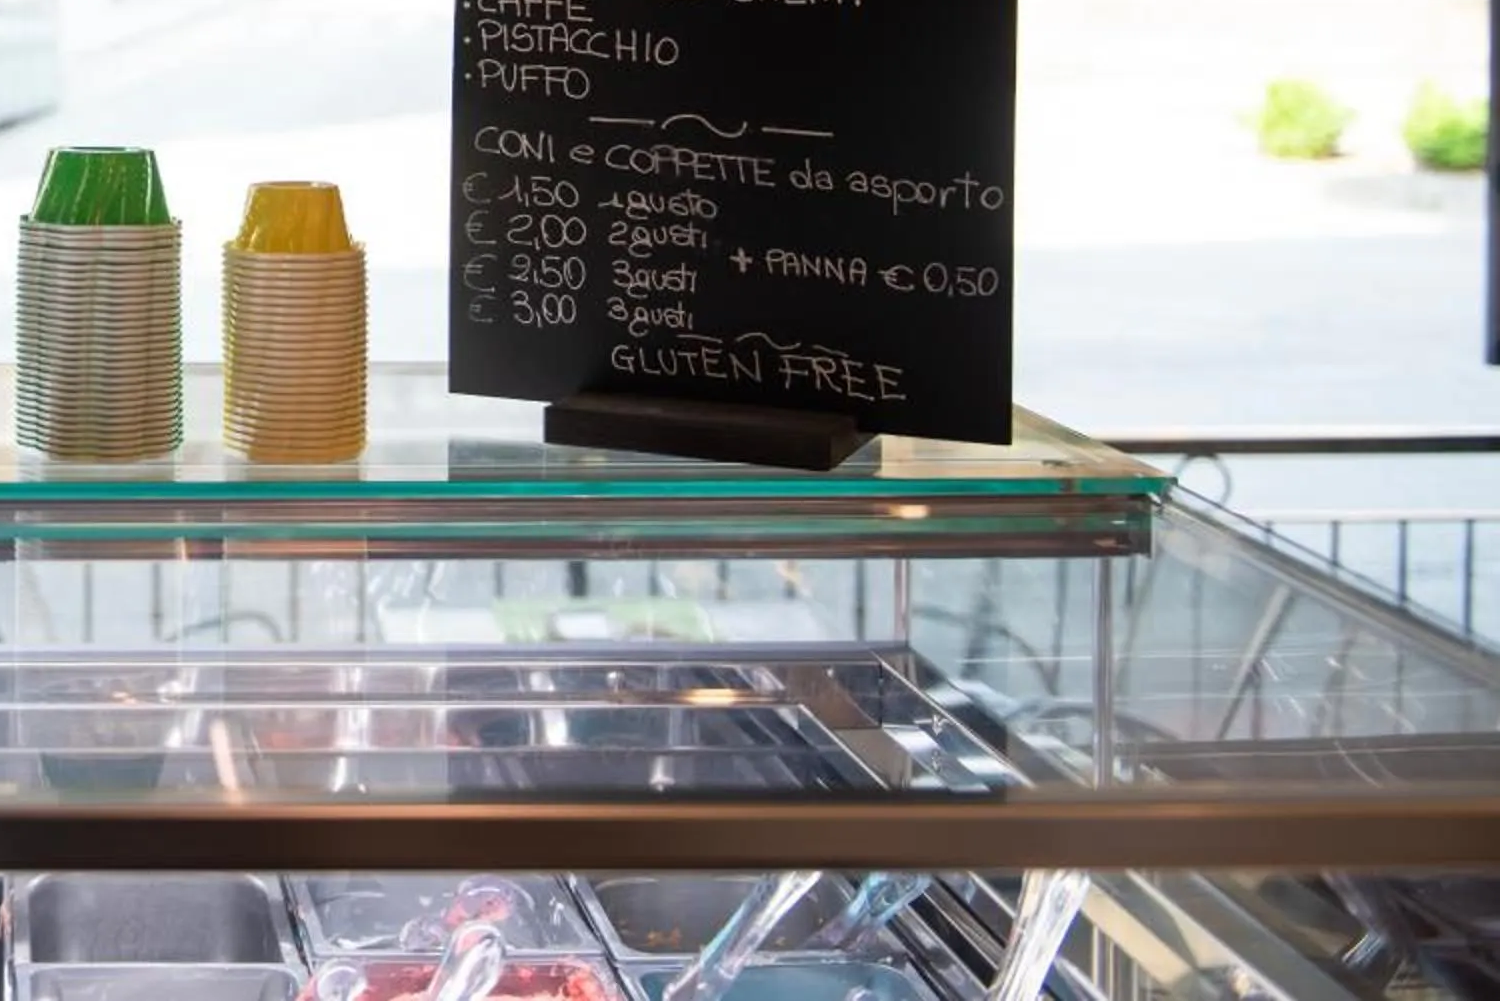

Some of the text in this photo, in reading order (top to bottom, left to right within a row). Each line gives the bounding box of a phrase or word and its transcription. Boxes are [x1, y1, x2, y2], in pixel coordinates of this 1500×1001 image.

[477, 19, 679, 65] PISTACCHIO
[477, 59, 590, 99] PUFFO
[462, 172, 491, 203] €
[499, 175, 579, 207] 1,50
[474, 126, 1004, 215] CONI e COPPETTE da asporto
[464, 209, 497, 245] €
[507, 214, 587, 250] 2,00
[461, 253, 498, 293] €
[765, 249, 867, 286] PANNA
[877, 264, 914, 291] €
[923, 262, 999, 296] 0,50
[510, 289, 577, 328] 3,00
[611, 344, 906, 401] GLUTEN FREE
